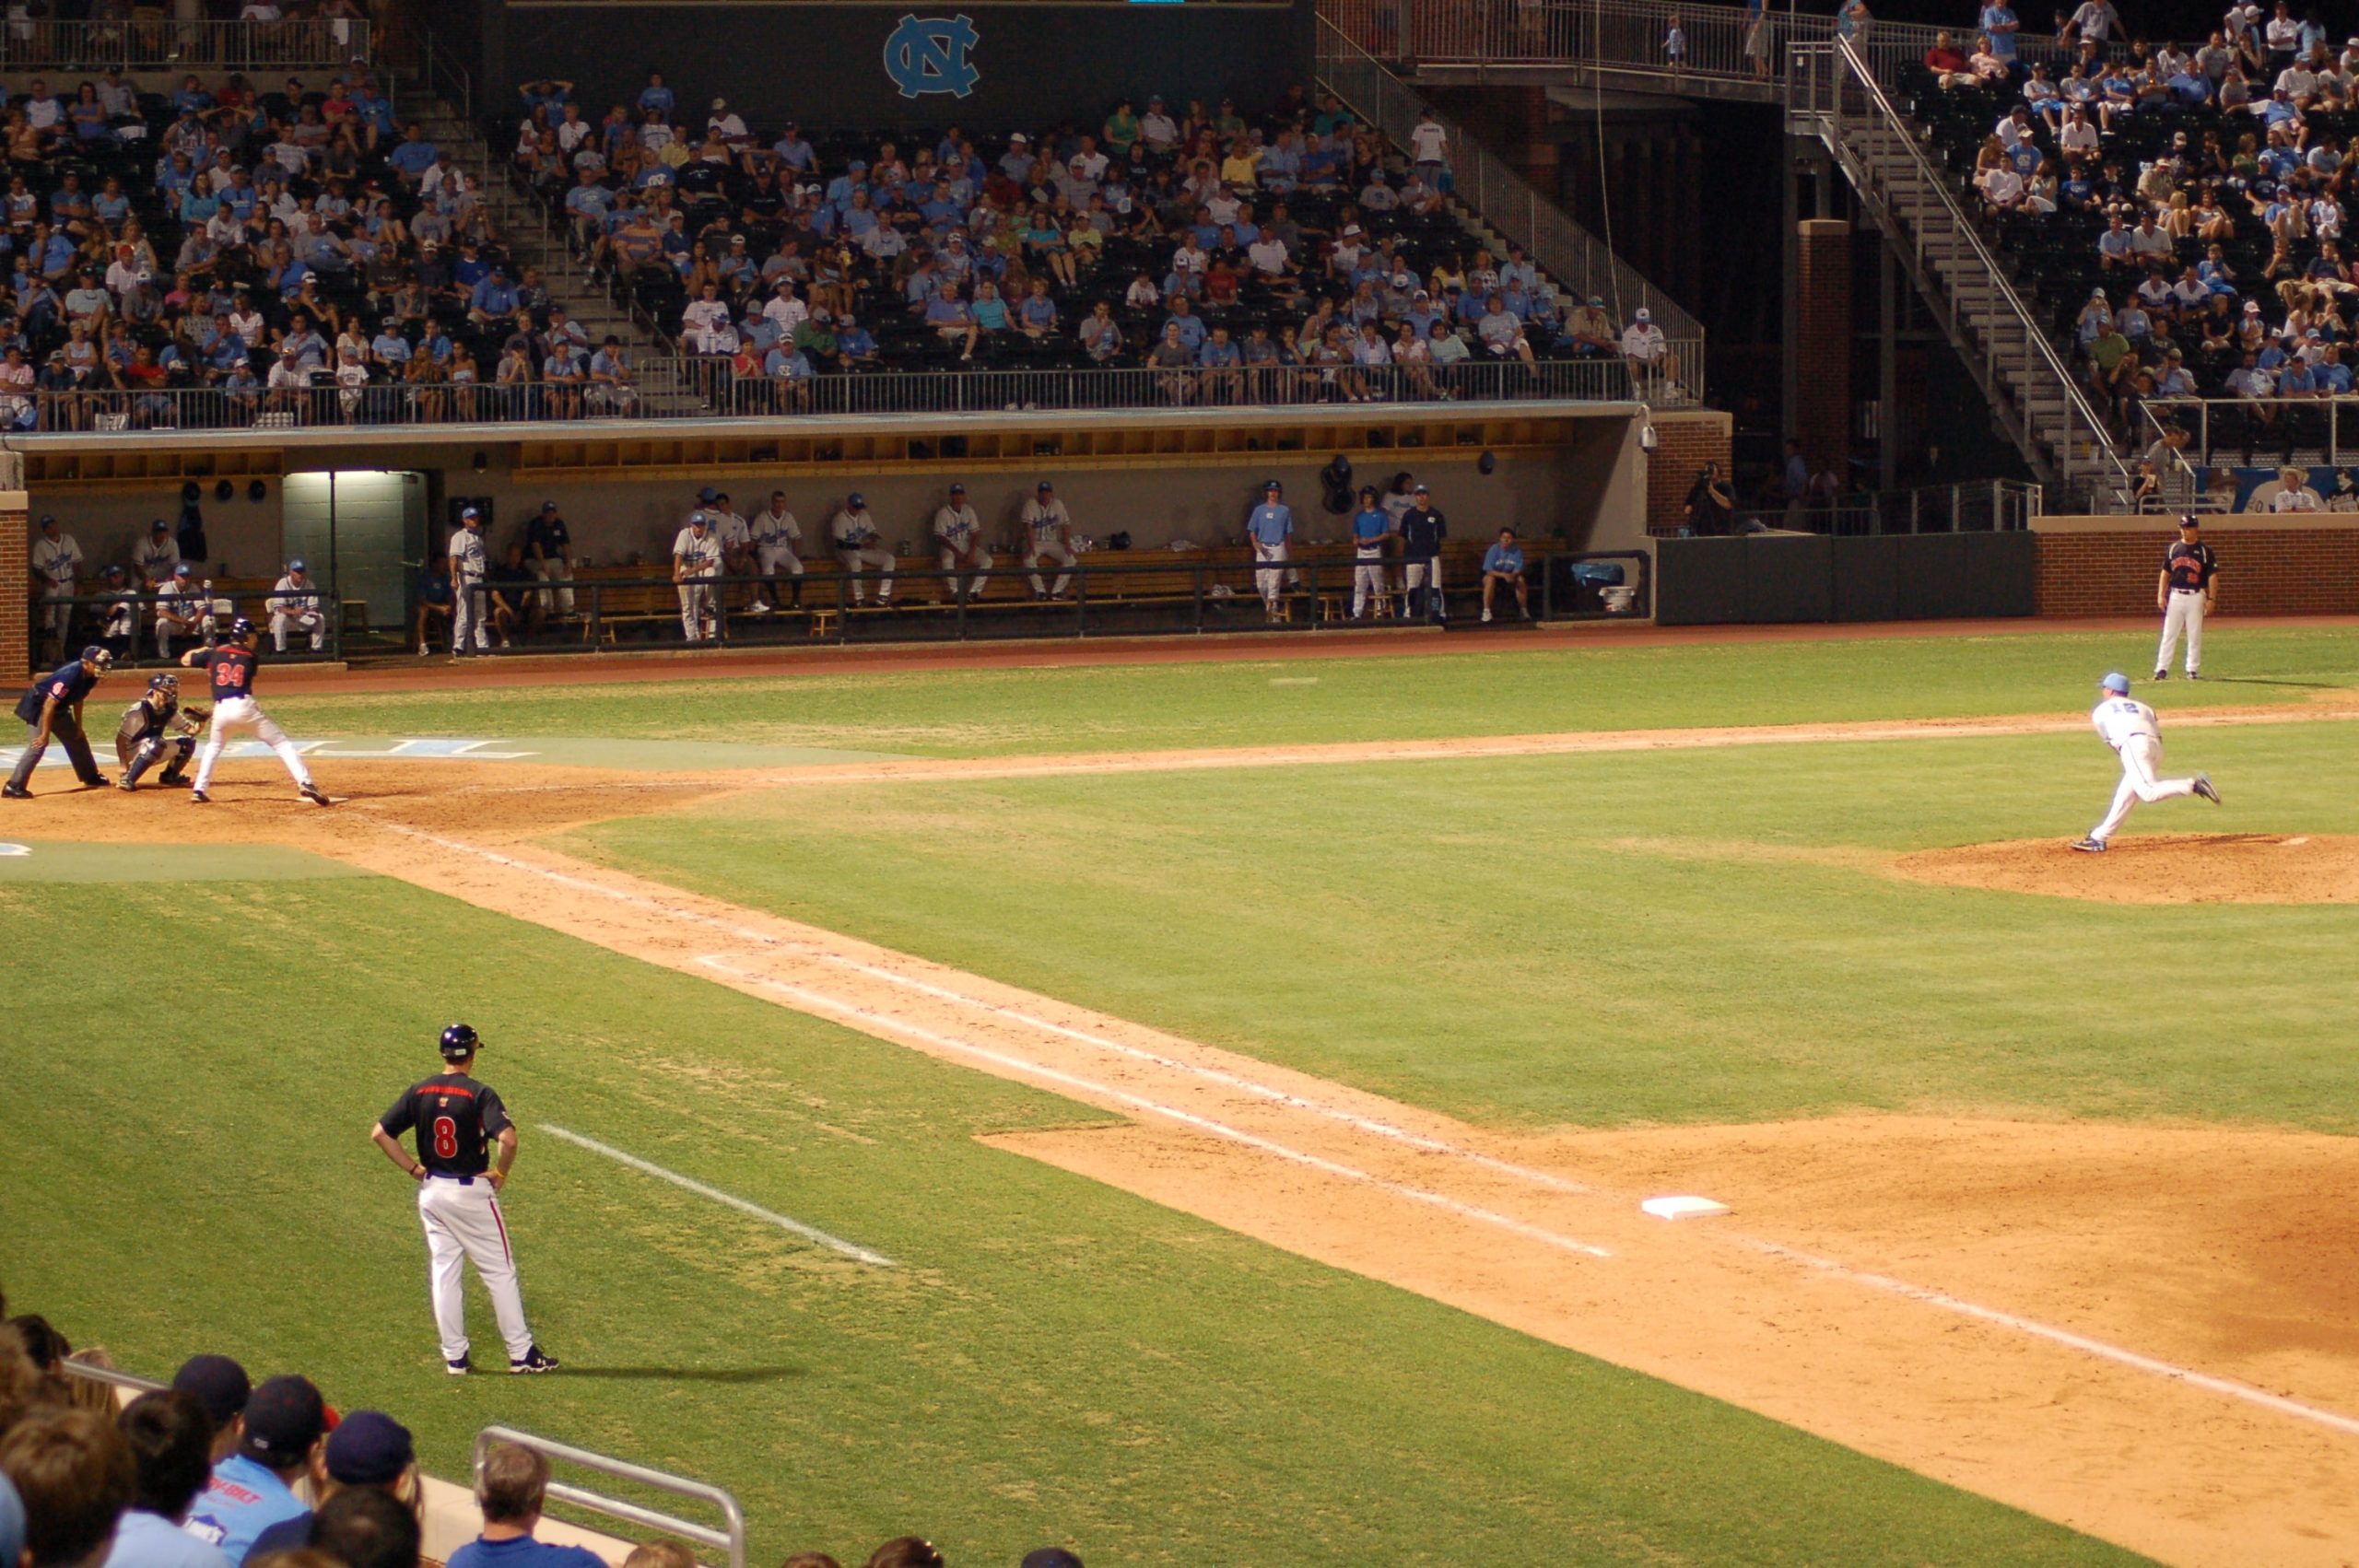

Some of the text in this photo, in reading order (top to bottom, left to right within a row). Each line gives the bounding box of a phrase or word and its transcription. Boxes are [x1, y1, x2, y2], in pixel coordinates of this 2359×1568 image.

[217, 662, 245, 687] 34
[2110, 702, 2140, 714] 12
[434, 1116, 458, 1158] 8
